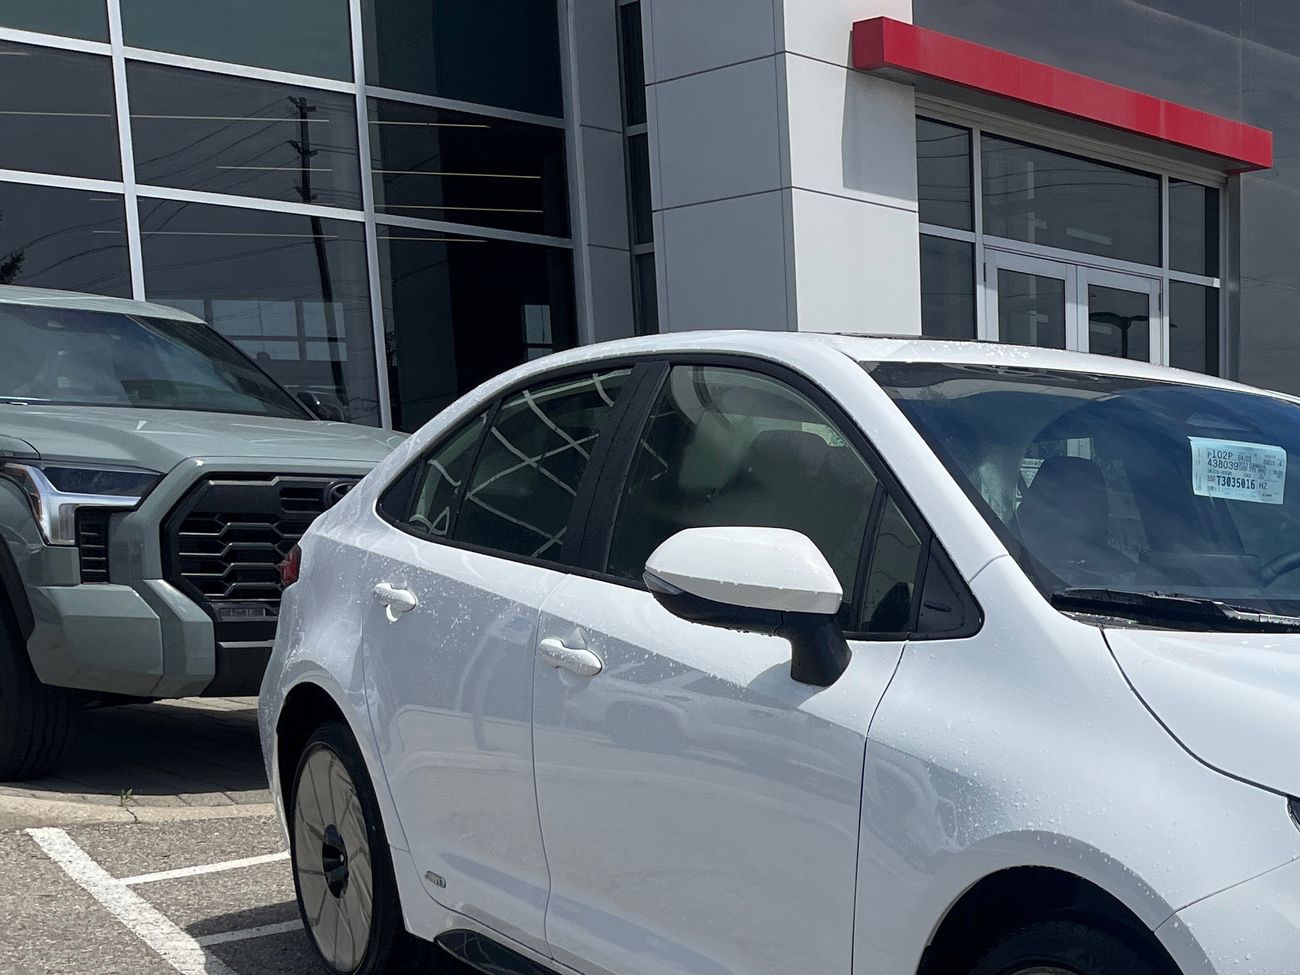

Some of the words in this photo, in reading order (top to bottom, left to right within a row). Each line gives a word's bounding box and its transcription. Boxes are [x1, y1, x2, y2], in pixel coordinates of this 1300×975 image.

[1207, 449, 1233, 460] P102P
[1207, 458, 1239, 471] 438039
[1216, 475, 1256, 490] T3035016
[1259, 482, 1268, 490] HZ
